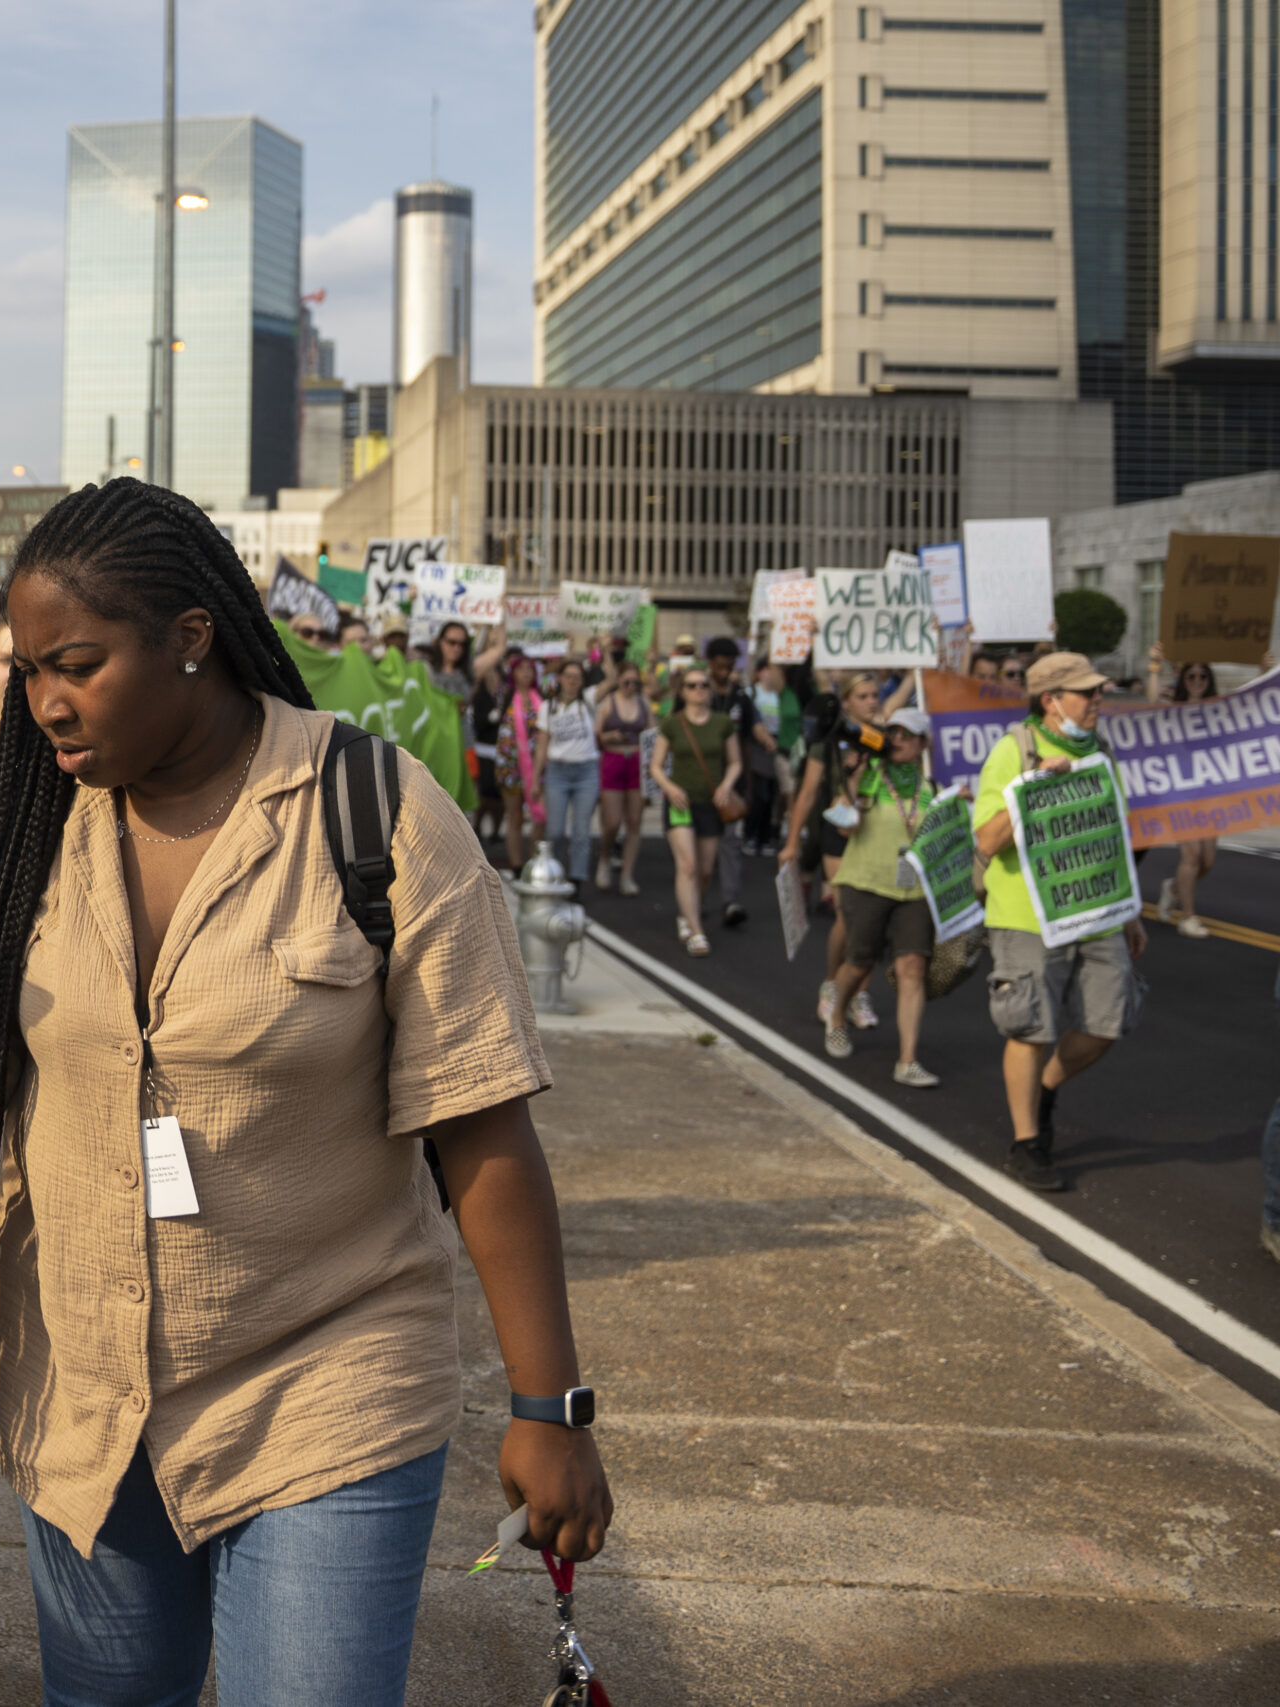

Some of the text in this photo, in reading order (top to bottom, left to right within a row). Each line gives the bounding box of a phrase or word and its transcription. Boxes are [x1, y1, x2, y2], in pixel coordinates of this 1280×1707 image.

[365, 540, 444, 573] FUCK
[823, 574, 877, 607] WE
[824, 613, 865, 656] GO
[873, 609, 936, 655] BACK
[1025, 773, 1104, 812] ABORTION
[1025, 802, 1119, 847] ON DEMAND
[1036, 836, 1120, 878] & WITHOUT
[1051, 869, 1119, 909] APOLOGY
